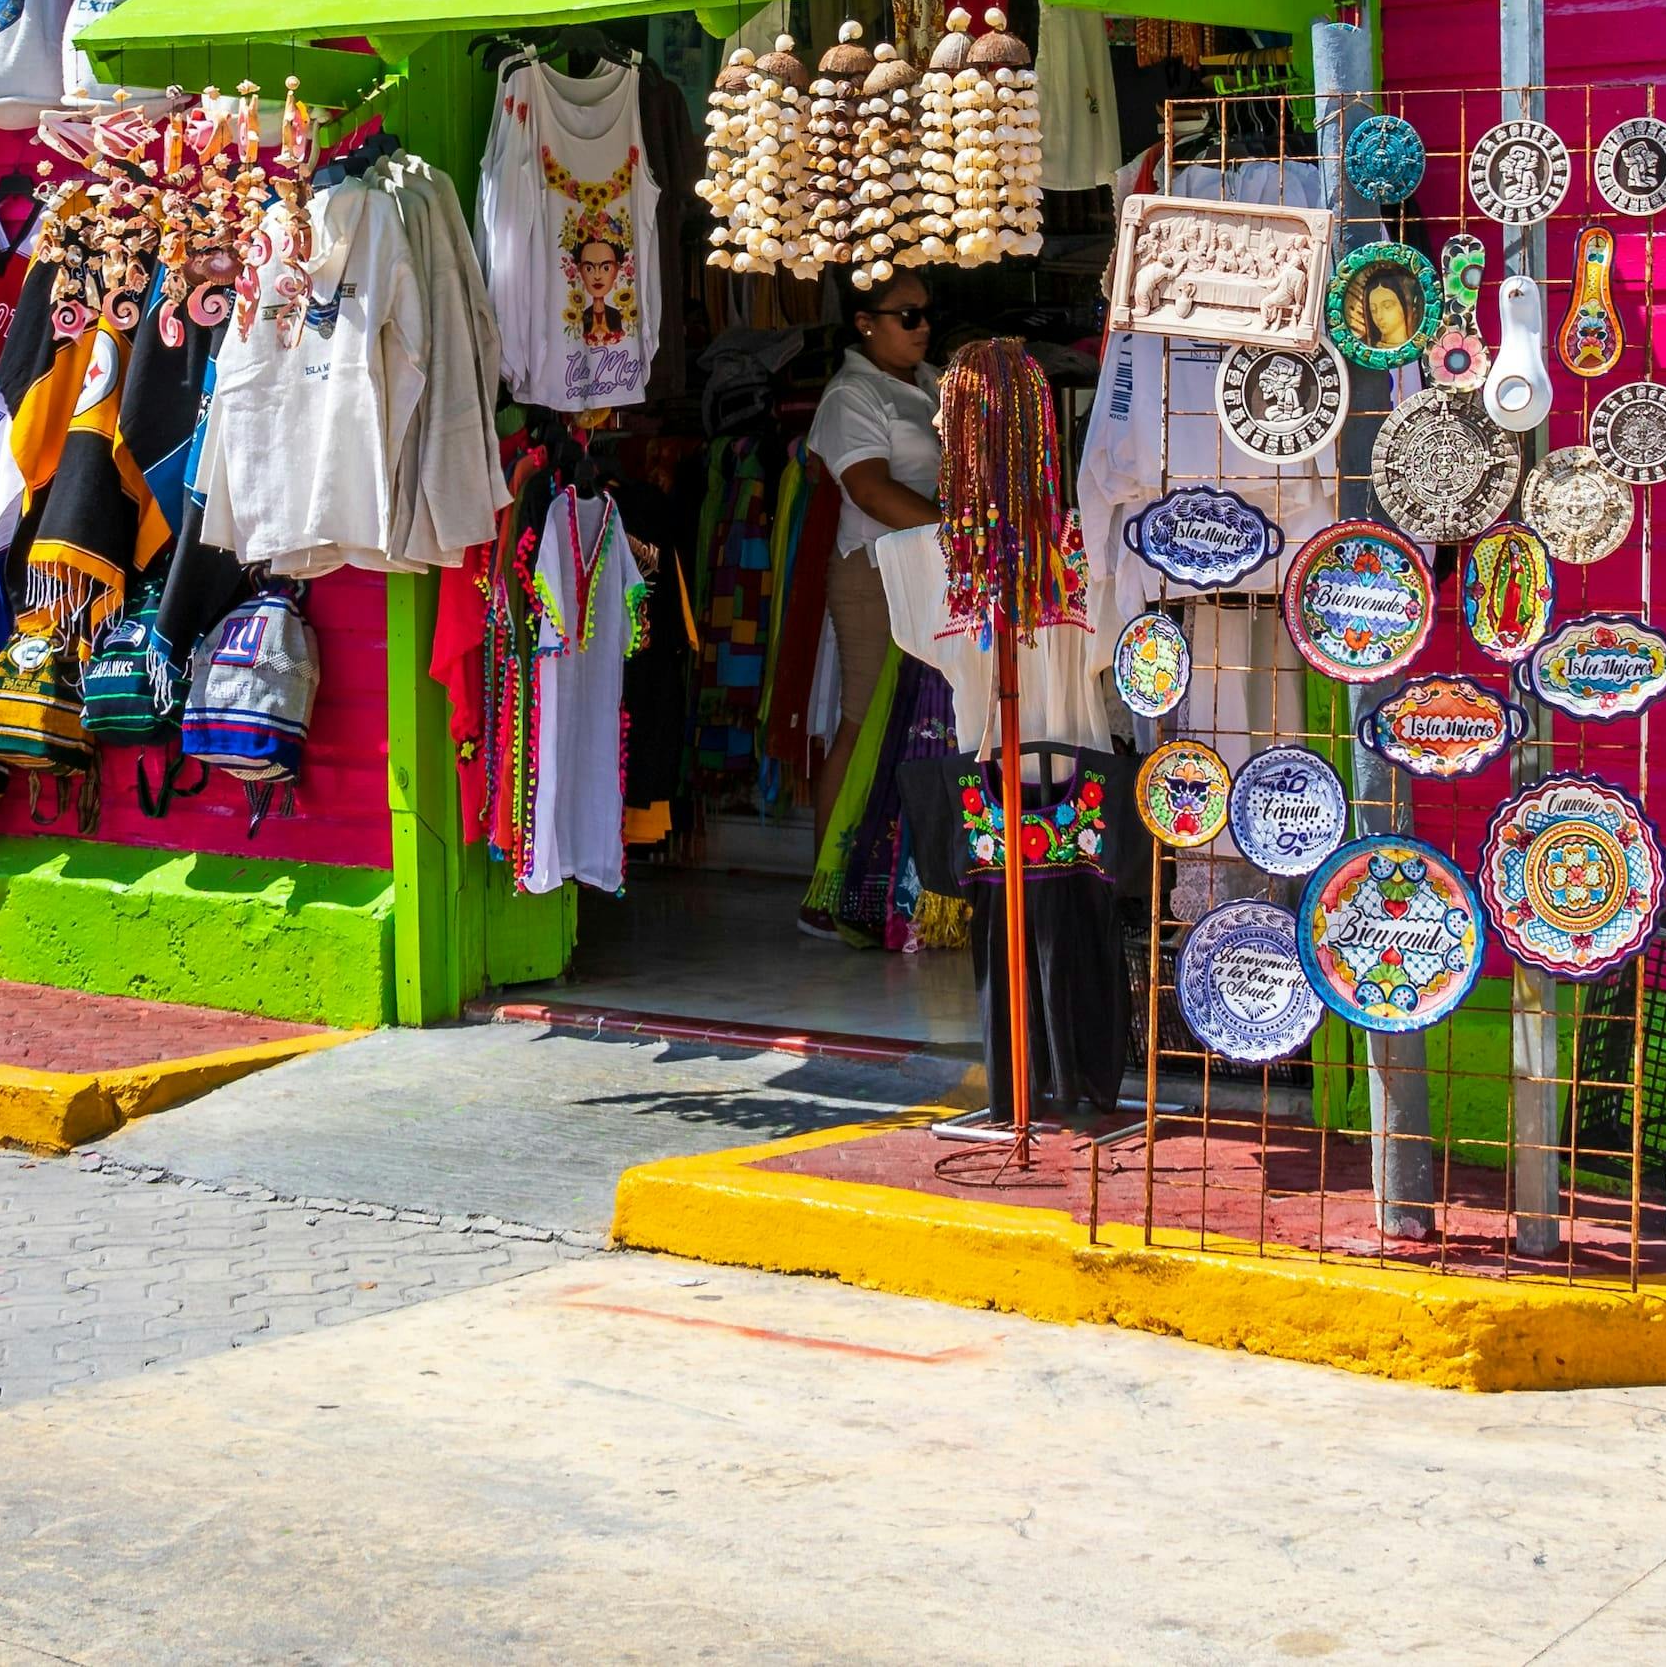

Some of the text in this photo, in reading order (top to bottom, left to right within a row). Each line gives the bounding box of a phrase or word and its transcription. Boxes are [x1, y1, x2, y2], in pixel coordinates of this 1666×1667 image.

[1171, 519, 1250, 551] Isla Mujeres
[1564, 657, 1653, 682] Isla Mujeres
[1405, 717, 1494, 738] Isla Mujeres
[1227, 965, 1245, 979] la
[1218, 980, 1276, 1001] Abuelo
